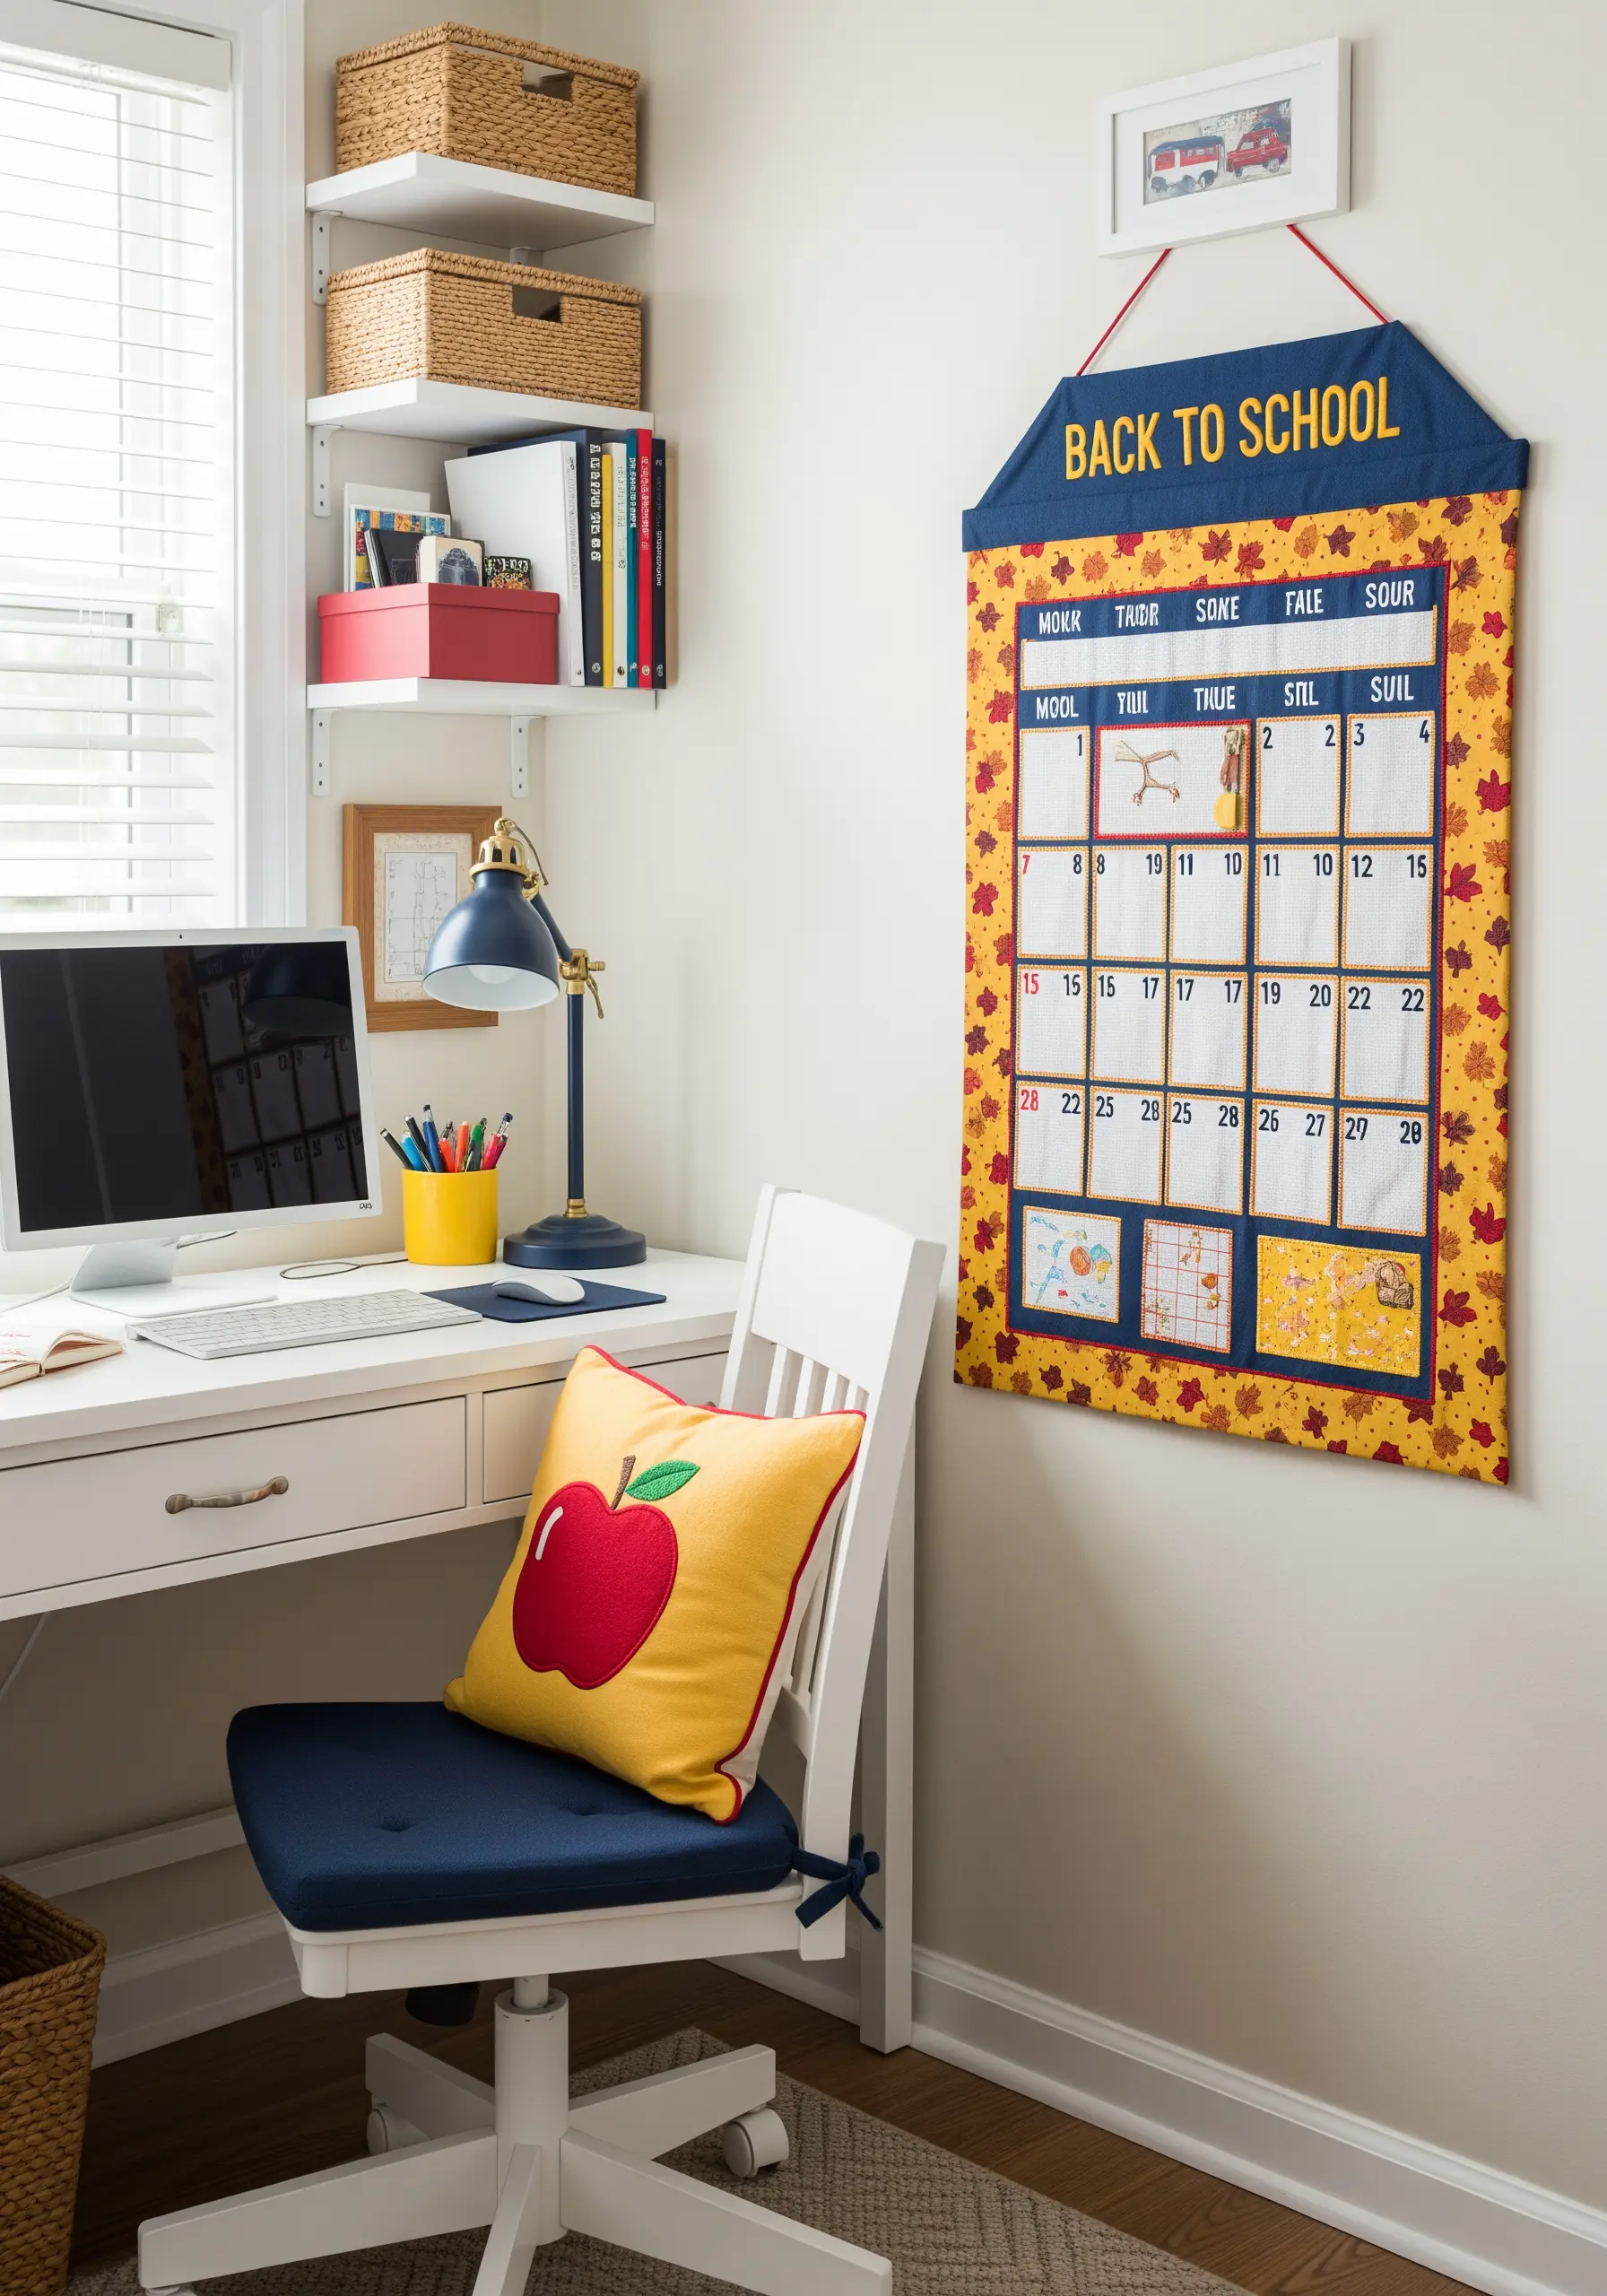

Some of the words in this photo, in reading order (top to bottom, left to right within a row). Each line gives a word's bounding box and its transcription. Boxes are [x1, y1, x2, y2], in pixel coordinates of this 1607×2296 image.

[1065, 412, 1162, 480] BACK
[1172, 403, 1225, 465] TO
[1238, 376, 1401, 457] SCHOOL
[1285, 588, 1325, 616] FALE
[1365, 579, 1414, 609] SOUR
[1263, 726, 1273, 750] 2
[1325, 724, 1336, 747] 2
[1353, 722, 1365, 746] 3
[1419, 719, 1430, 744] 4
[1076, 734, 1082, 757] 1
[1022, 855, 1030, 874] 7
[1073, 853, 1082, 875] 8
[1096, 853, 1106, 875] 8
[1145, 853, 1163, 875] 19
[1177, 853, 1194, 876] 11
[1224, 852, 1242, 875] 10
[1263, 853, 1281, 877] 11
[1313, 852, 1333, 876] 10
[1351, 854, 1374, 878] 12
[1023, 972, 1039, 995] 15
[1142, 976, 1160, 999] 17
[1176, 978, 1194, 1002] 17
[1224, 978, 1243, 1004] 17
[1260, 981, 1281, 1004] 19
[1309, 984, 1332, 1007] 20
[1347, 986, 1371, 1010] 22
[1401, 987, 1425, 1013] 22
[1020, 1089, 1038, 1111] 28
[1061, 1092, 1081, 1115] 22
[1095, 1095, 1115, 1118] 25
[1141, 1099, 1160, 1122] 28
[1171, 1101, 1192, 1125] 25
[1218, 1104, 1239, 1128] 28
[1258, 1109, 1280, 1133] 26
[1305, 1113, 1326, 1137] 27
